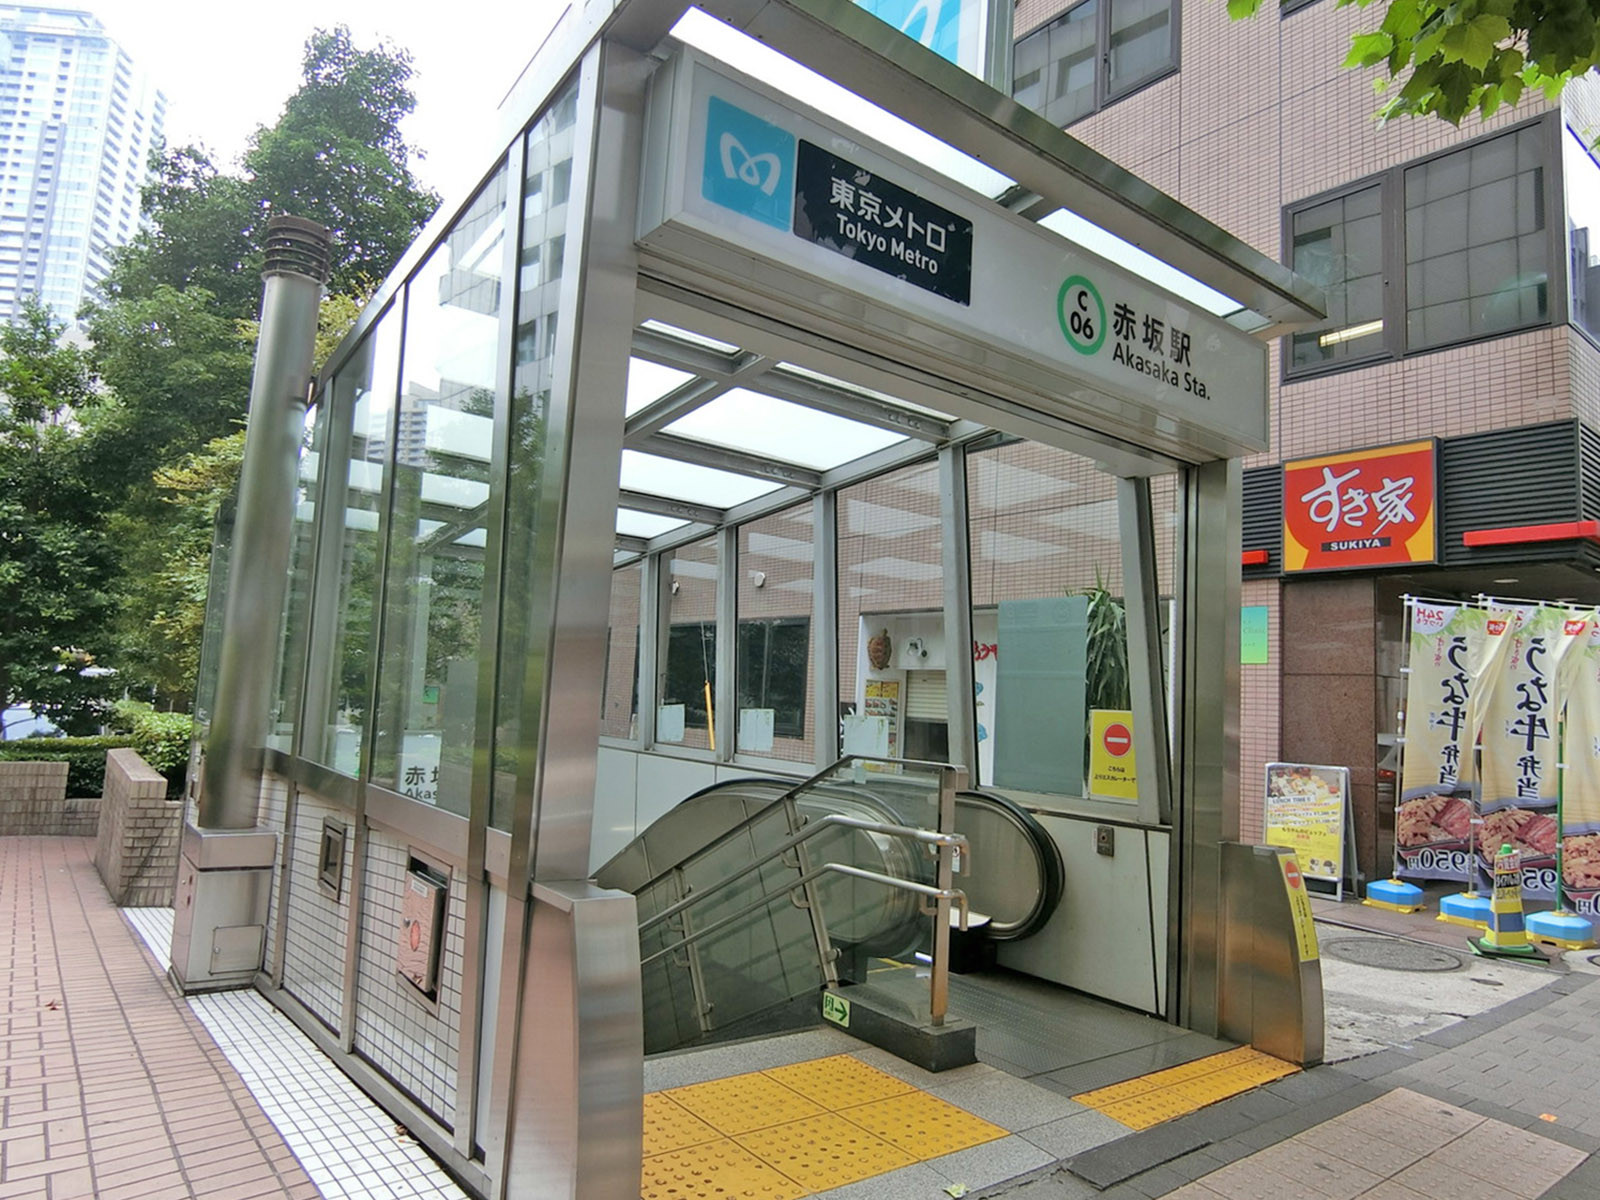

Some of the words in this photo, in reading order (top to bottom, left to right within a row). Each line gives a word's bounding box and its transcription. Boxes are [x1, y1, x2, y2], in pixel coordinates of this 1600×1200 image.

[830, 176, 946, 253] 東京メトロ
[836, 213, 887, 252] Tokyo
[891, 237, 938, 274] Metro
[1070, 311, 1094, 340] 06
[1077, 290, 1088, 312] C
[1112, 303, 1191, 368] 赤坂駅
[1112, 342, 1179, 388] Akasaka
[1183, 372, 1210, 400] Sta.
[1301, 466, 1416, 536] すき家
[1330, 538, 1381, 551] SUKIYA
